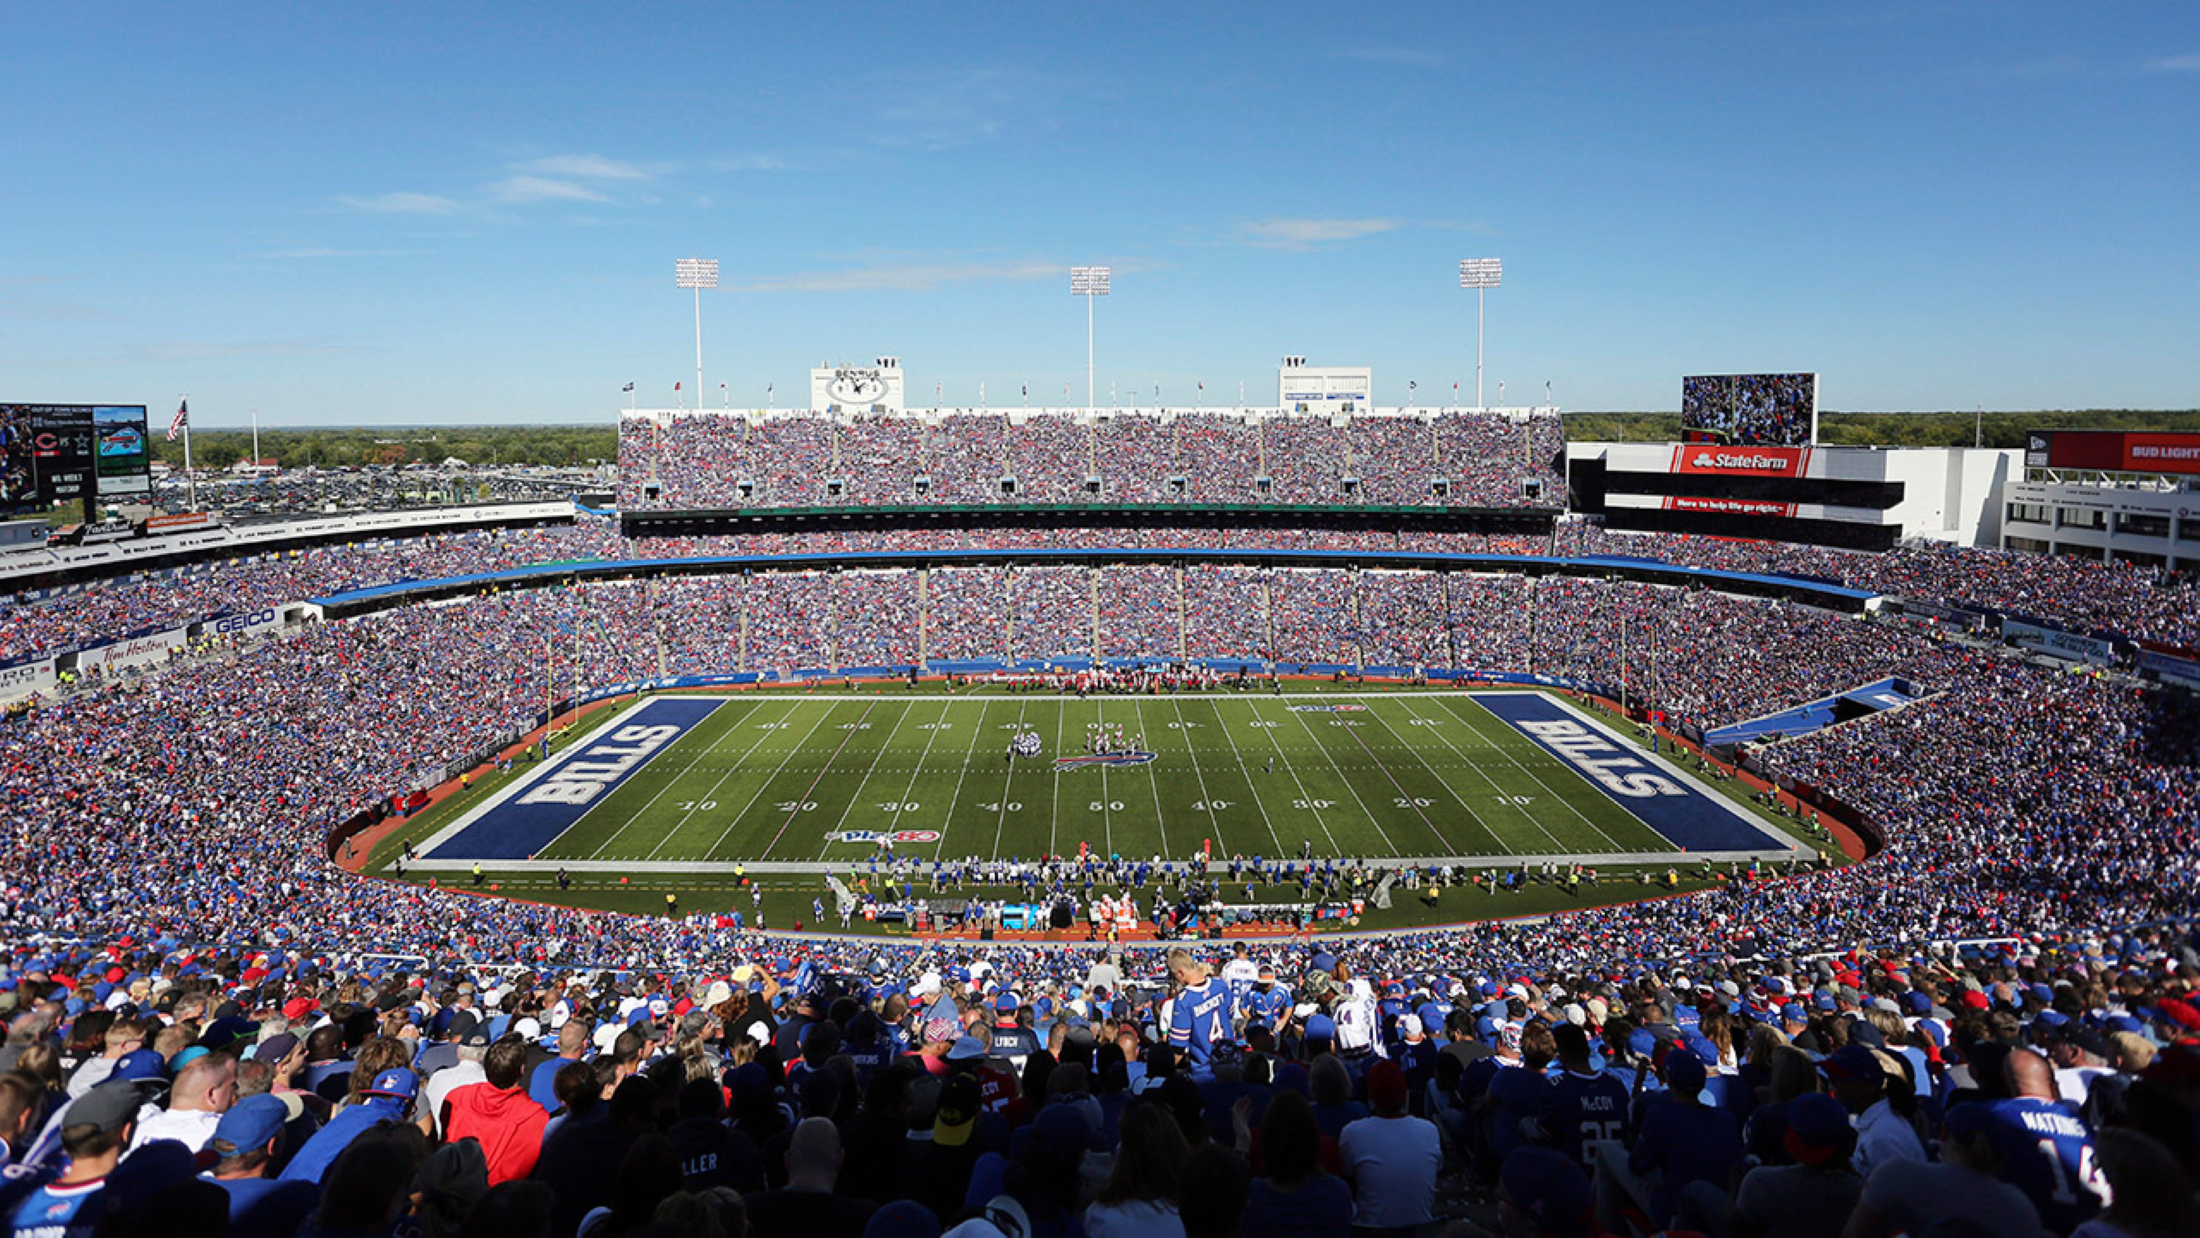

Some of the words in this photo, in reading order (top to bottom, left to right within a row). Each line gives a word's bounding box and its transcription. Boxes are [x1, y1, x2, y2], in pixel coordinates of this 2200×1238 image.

[835, 370, 880, 378] BENRUS
[2132, 446, 2159, 458] BUD
[2161, 447, 2200, 460] LIGHT
[1715, 453, 1752, 468] State
[1752, 455, 1787, 469] Farm
[85, 519, 130, 535] FanDuel
[215, 608, 275, 633] GEICO
[102, 645, 125, 663] Tim
[126, 640, 169, 657] Hortons
[515, 725, 681, 804] BILLS
[1515, 720, 1689, 797] BILLS
[679, 801, 717, 810] 10
[779, 801, 818, 811] 20
[883, 801, 919, 811] 30
[985, 802, 1022, 811] 40
[1089, 801, 1125, 811] 50
[1191, 800, 1227, 811] 40
[1293, 799, 1329, 809] 30
[1393, 798, 1430, 808] 20
[1496, 796, 1530, 805] 10
[1337, 1010, 1353, 1025] 14
[1209, 1010, 1224, 1043] 4
[1580, 1096, 1614, 1111] McCOY
[2020, 1111, 2087, 1138] WATKINS
[1580, 1121, 1622, 1165] 25
[2038, 1139, 2113, 1208] 14
